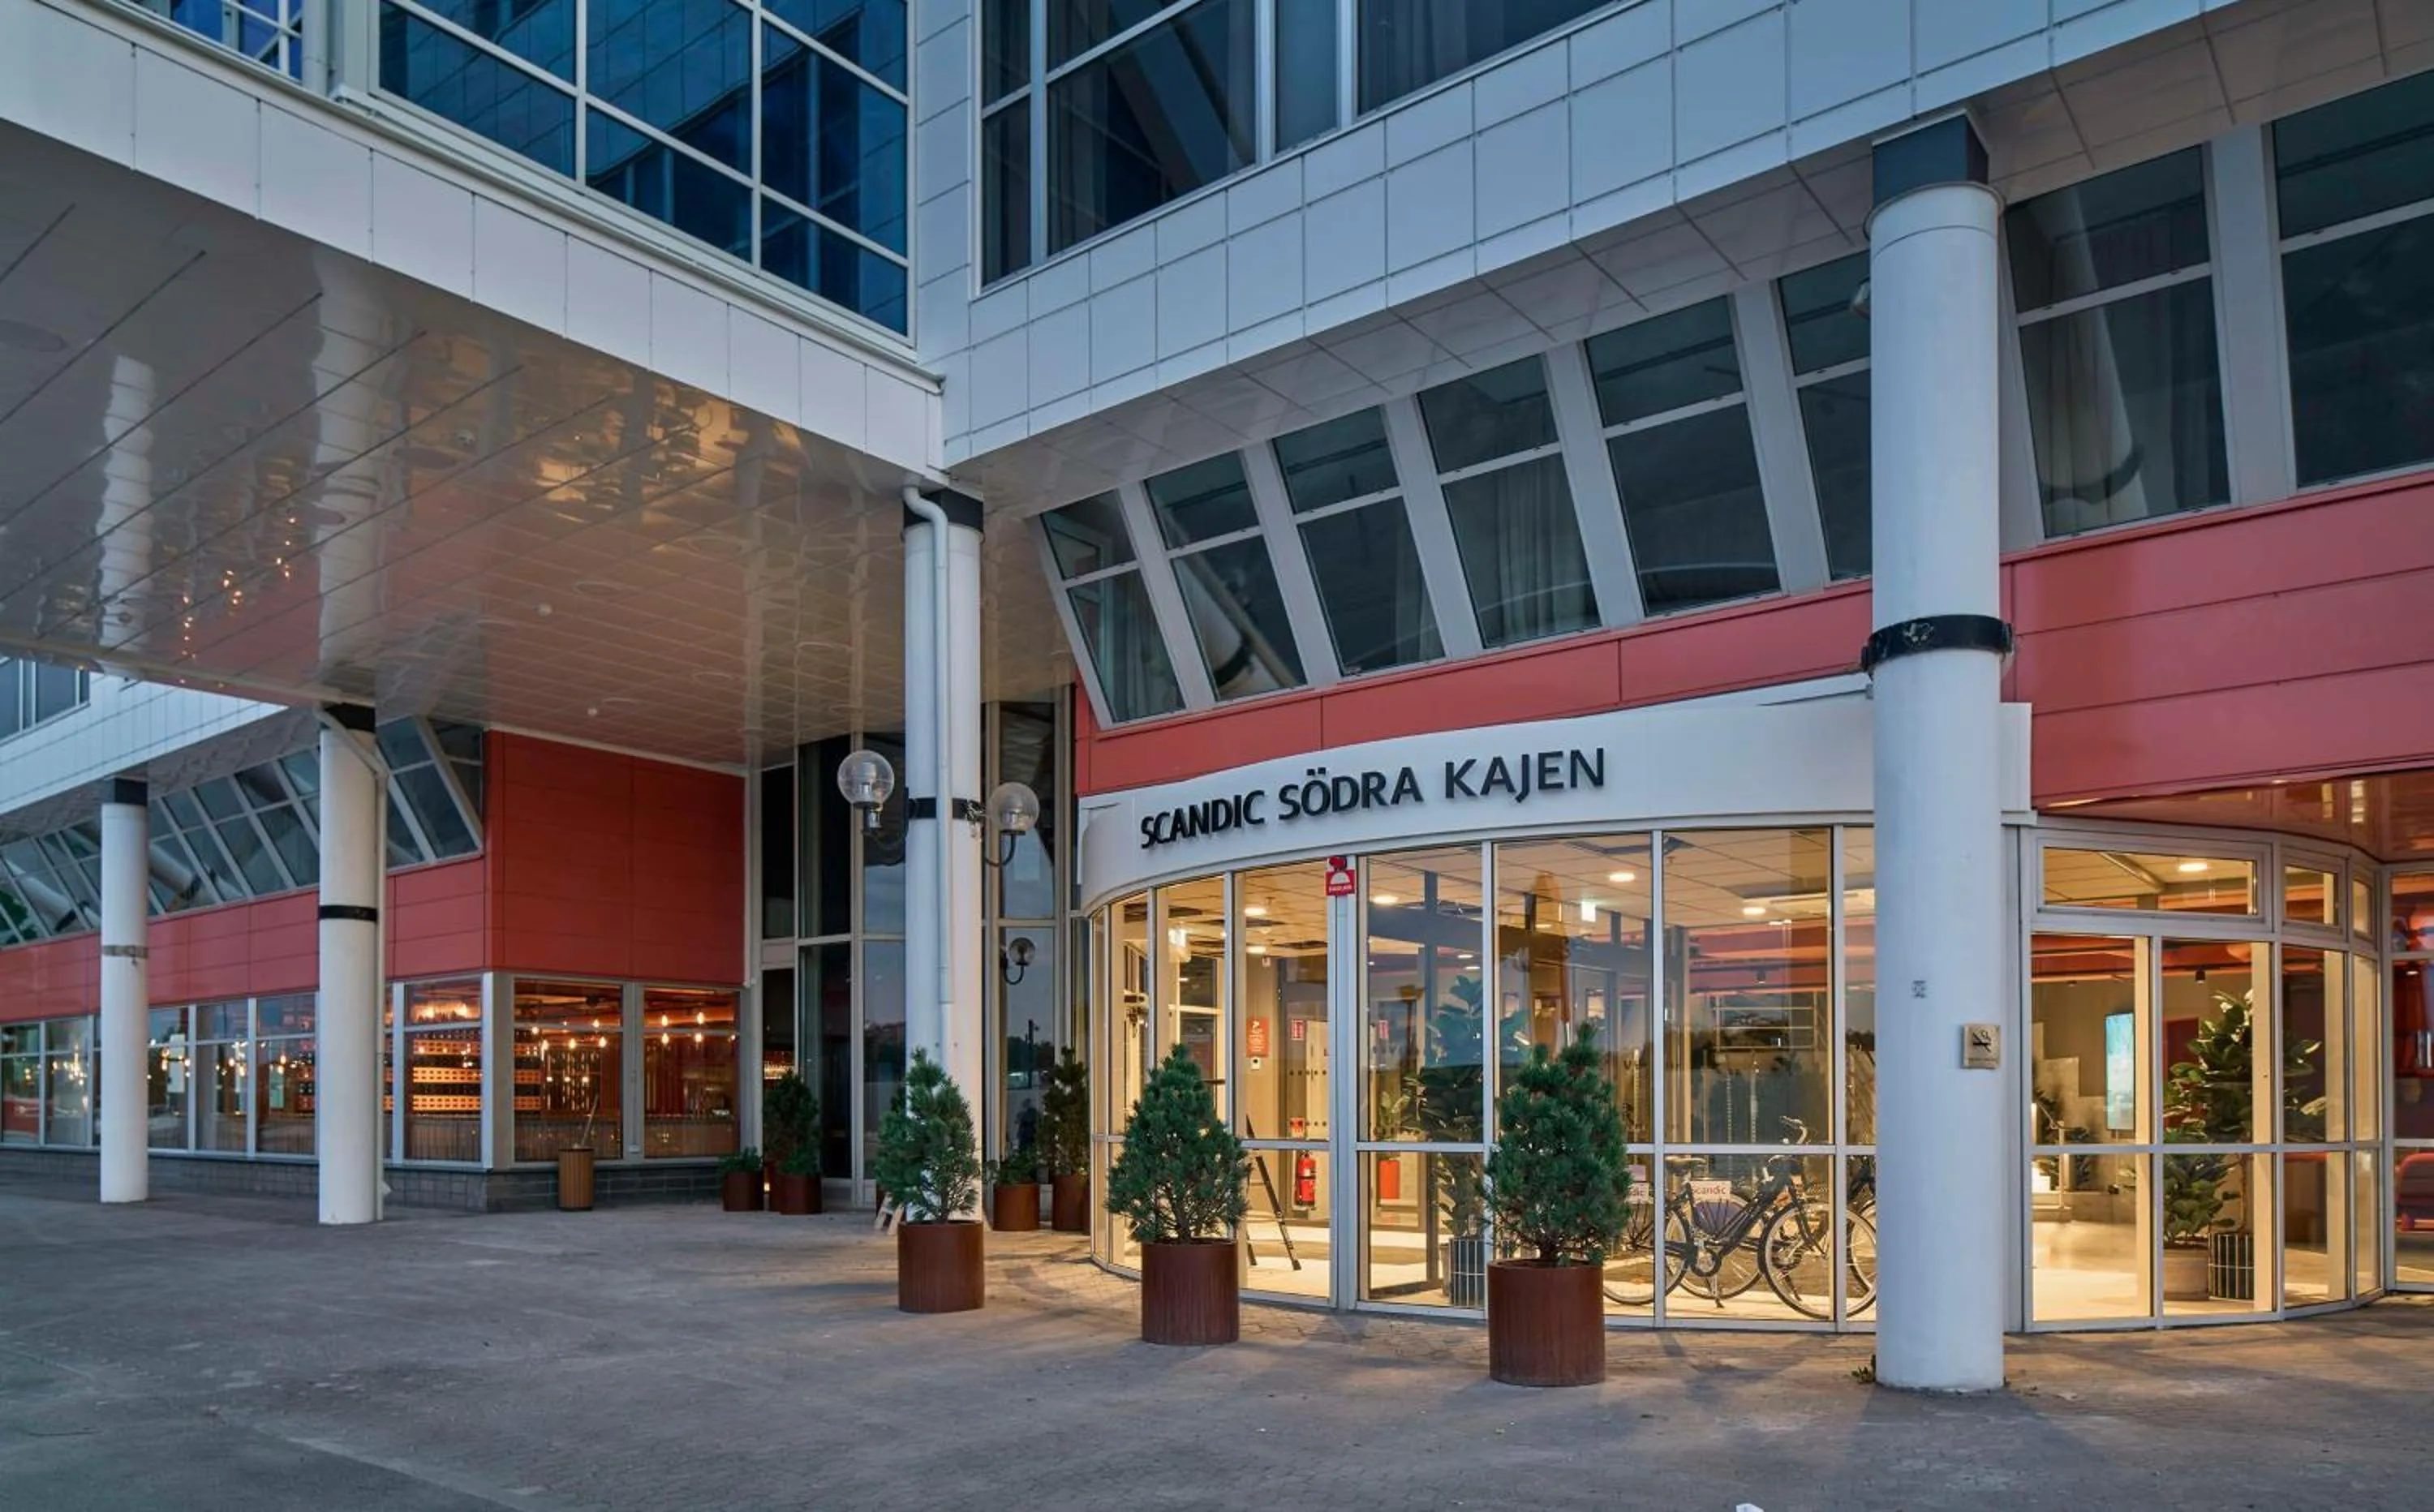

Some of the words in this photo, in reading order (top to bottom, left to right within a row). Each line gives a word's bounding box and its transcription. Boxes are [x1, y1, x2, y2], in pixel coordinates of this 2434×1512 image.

[1140, 789, 1266, 849] SCANDIC
[1278, 767, 1424, 821] SÖDRA
[1444, 747, 1604, 804] KAJEN
